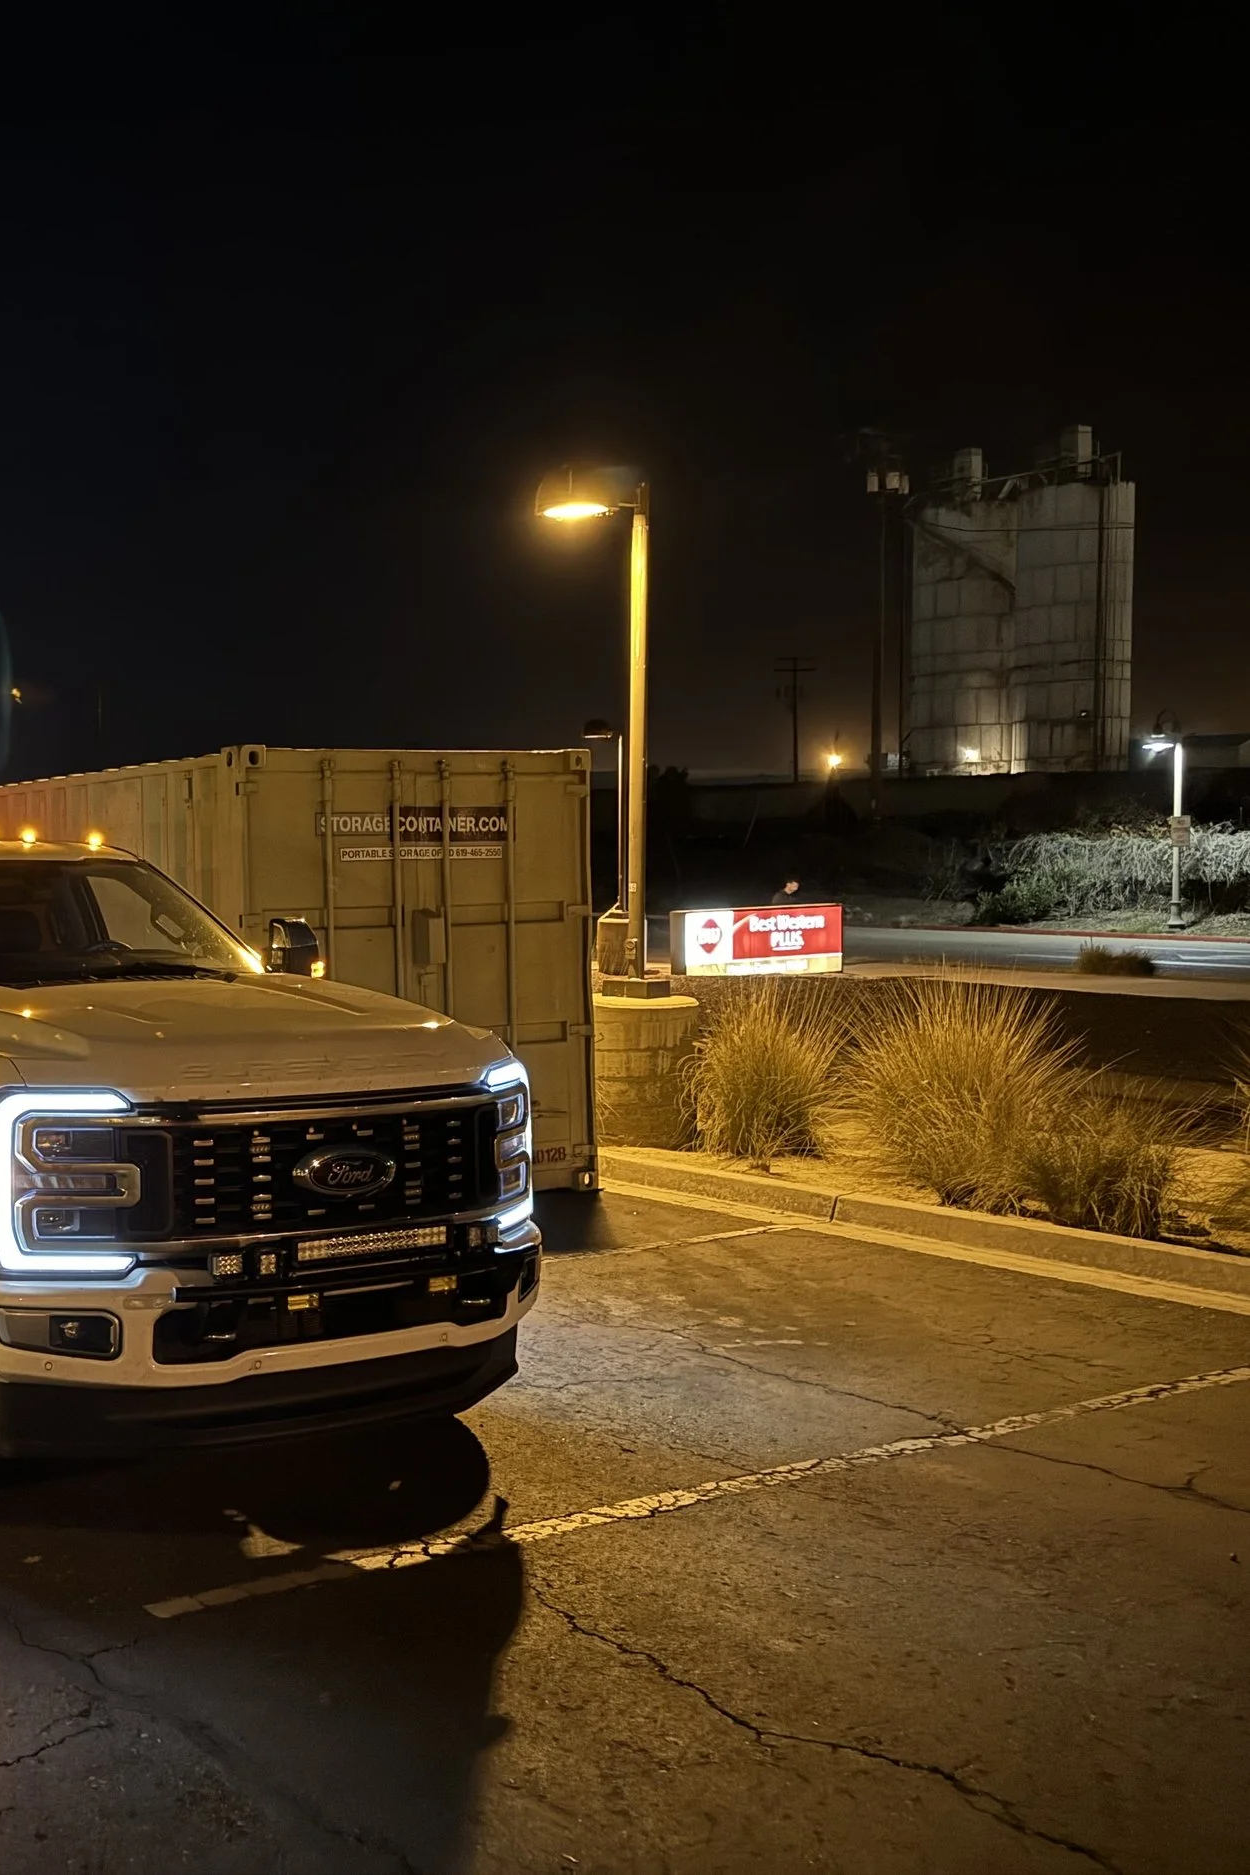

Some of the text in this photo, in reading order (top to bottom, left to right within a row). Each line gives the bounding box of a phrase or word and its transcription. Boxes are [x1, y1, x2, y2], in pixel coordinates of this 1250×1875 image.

[320, 816, 508, 833] STORAGE CONTANER.COM
[341, 849, 387, 859] PORTABLE
[388, 848, 430, 858] SORAGE
[770, 931, 804, 947] PLUS
[533, 1146, 567, 1165] 0128
[328, 1161, 374, 1184] Ford
